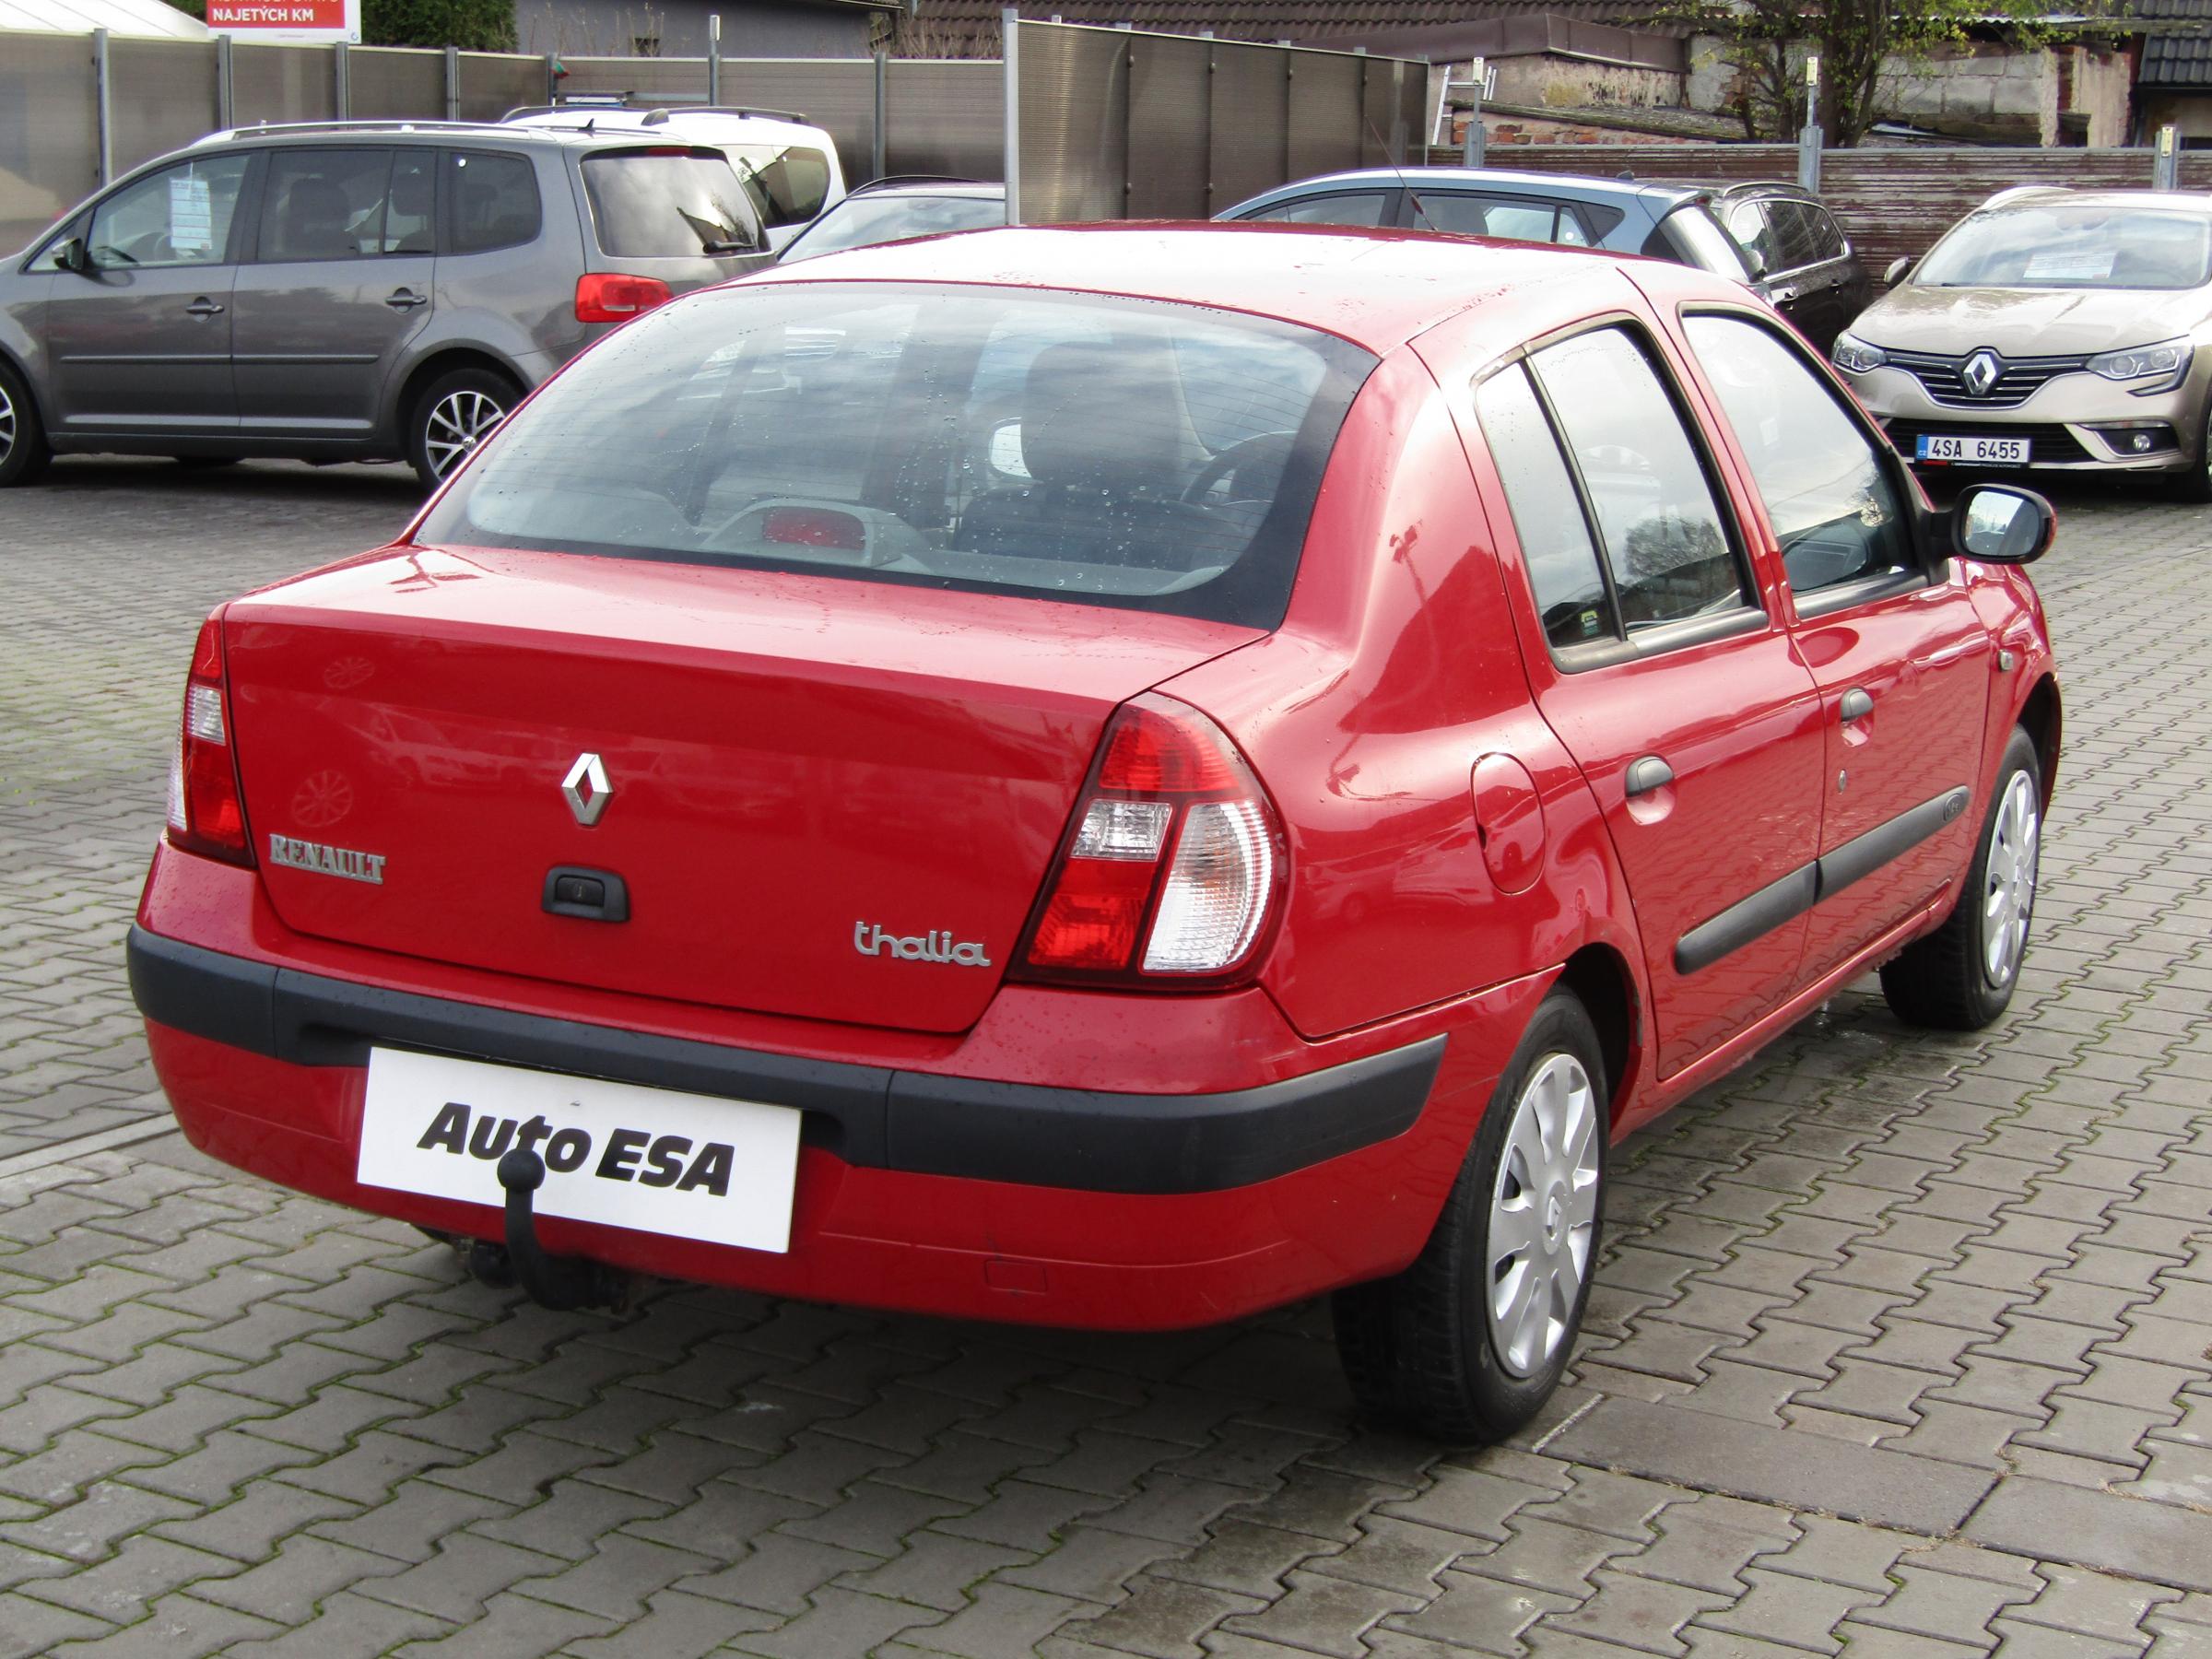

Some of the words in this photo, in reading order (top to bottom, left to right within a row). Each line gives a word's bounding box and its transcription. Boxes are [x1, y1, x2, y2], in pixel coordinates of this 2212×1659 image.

[213, 6, 288, 21] NAJETÝCH
[292, 8, 314, 21] KM
[1932, 440, 1962, 457] 4SA
[1977, 441, 2019, 459] 6455
[269, 833, 385, 885] RENAULT
[854, 921, 991, 967] thalia
[417, 1102, 592, 1173] Auto
[595, 1128, 735, 1197] ESA
